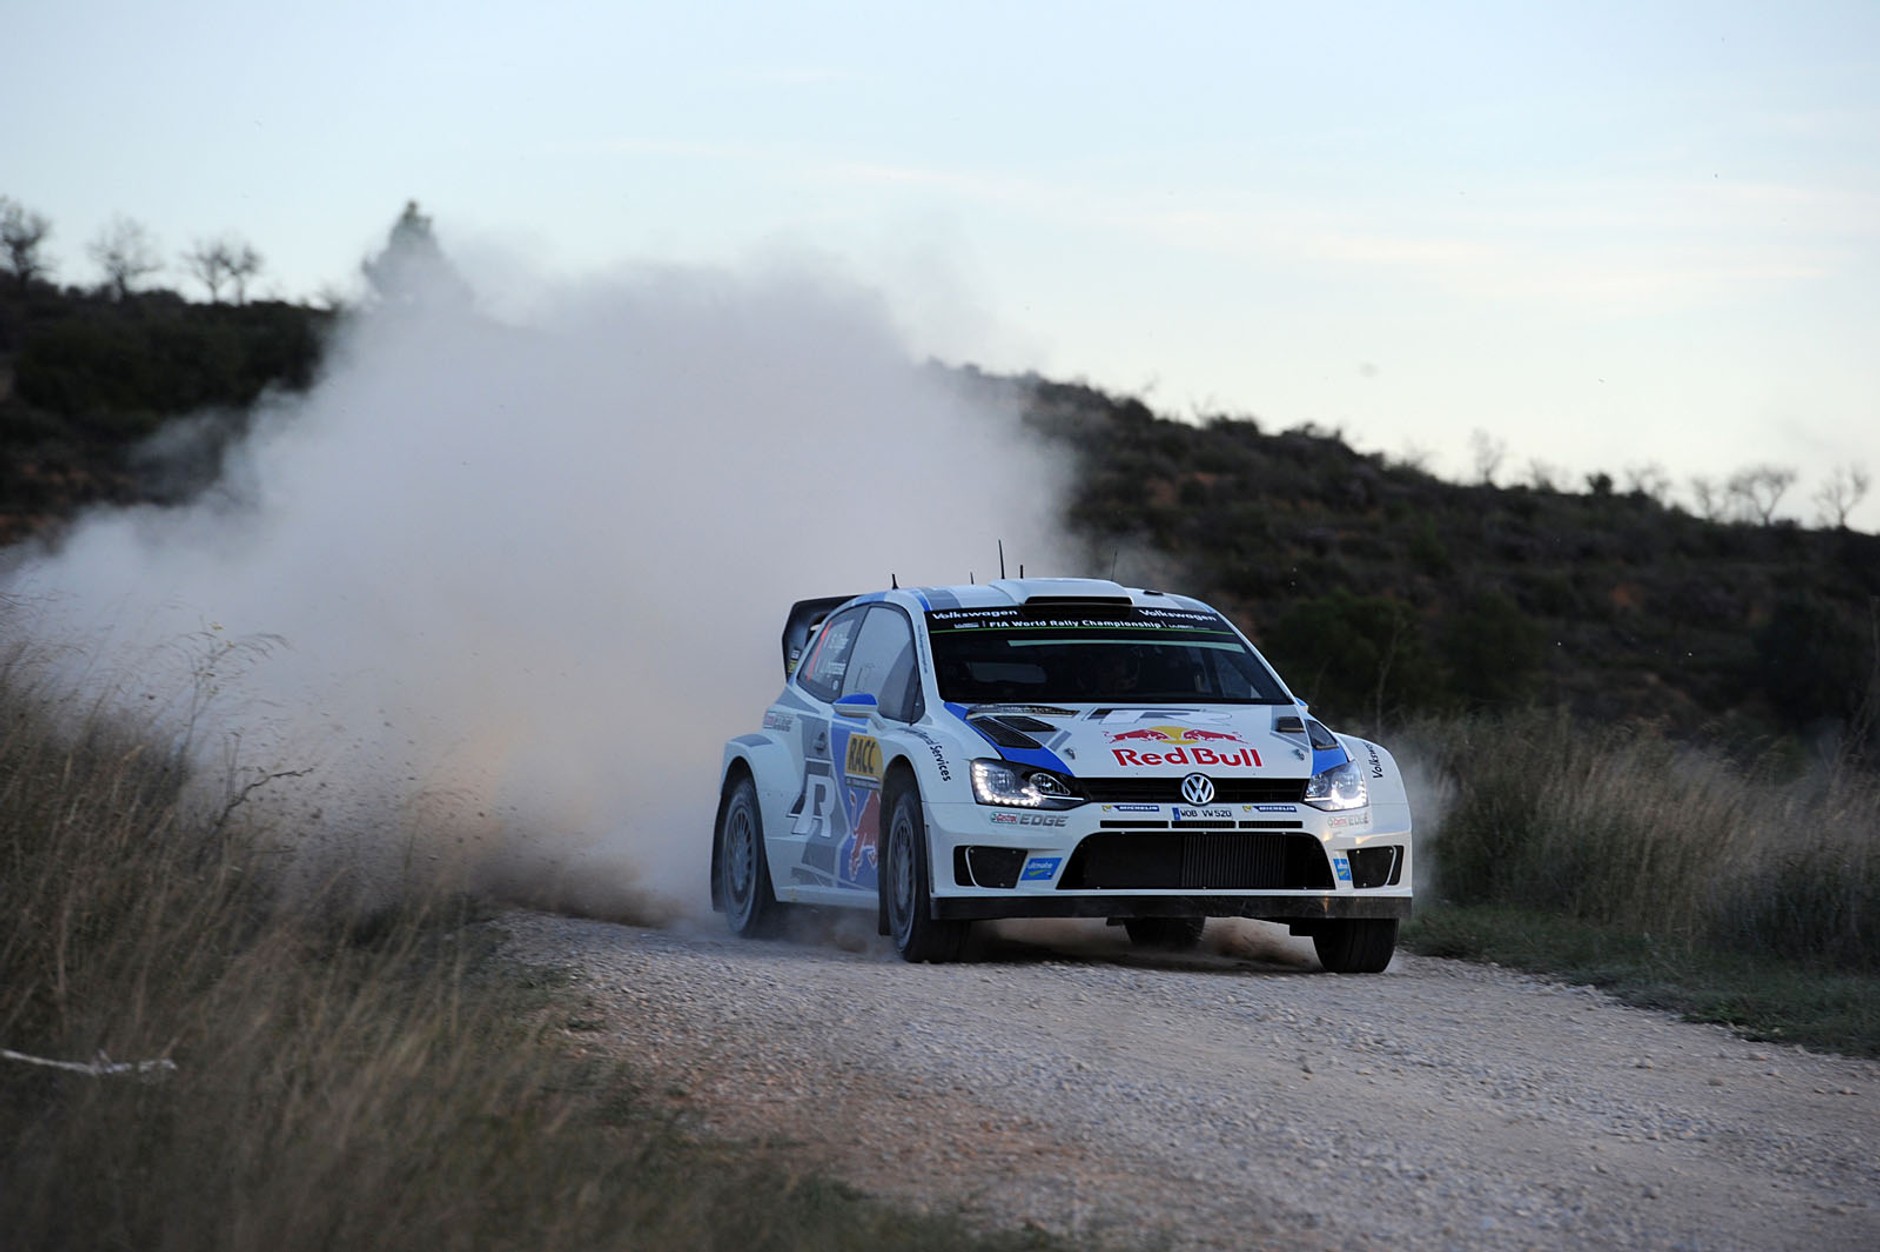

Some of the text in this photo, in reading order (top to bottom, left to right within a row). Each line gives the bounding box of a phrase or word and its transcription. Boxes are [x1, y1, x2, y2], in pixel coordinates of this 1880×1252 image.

[932, 610, 1018, 620] Volkswagen
[1138, 609, 1217, 621] Volkswagen
[1050, 620, 1079, 628] Rally
[1082, 620, 1161, 629] Championship
[848, 737, 877, 775] RACC
[1111, 747, 1263, 767] Red Bull
[930, 745, 952, 782] Services
[1180, 809, 1198, 817] WOB
[1201, 809, 1213, 817] VW
[1019, 813, 1069, 828] EDGE
